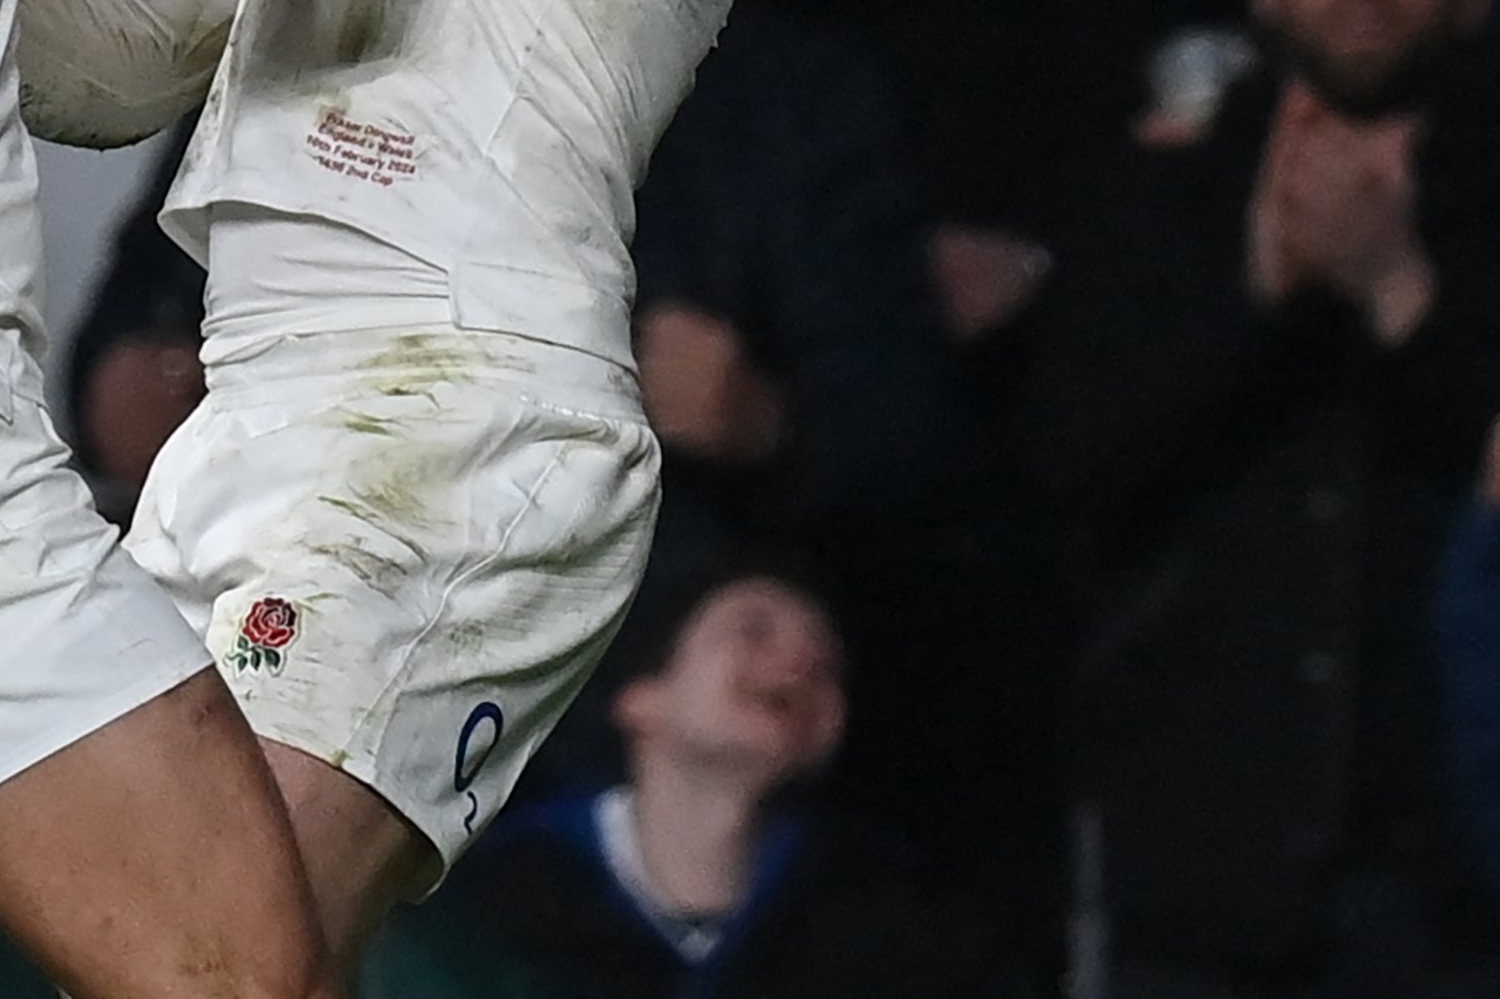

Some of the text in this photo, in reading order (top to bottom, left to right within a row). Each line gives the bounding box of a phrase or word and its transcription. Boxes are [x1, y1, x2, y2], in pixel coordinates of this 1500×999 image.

[333, 145, 385, 170] February
[387, 159, 416, 174] 2024
[371, 172, 393, 187] Cap
